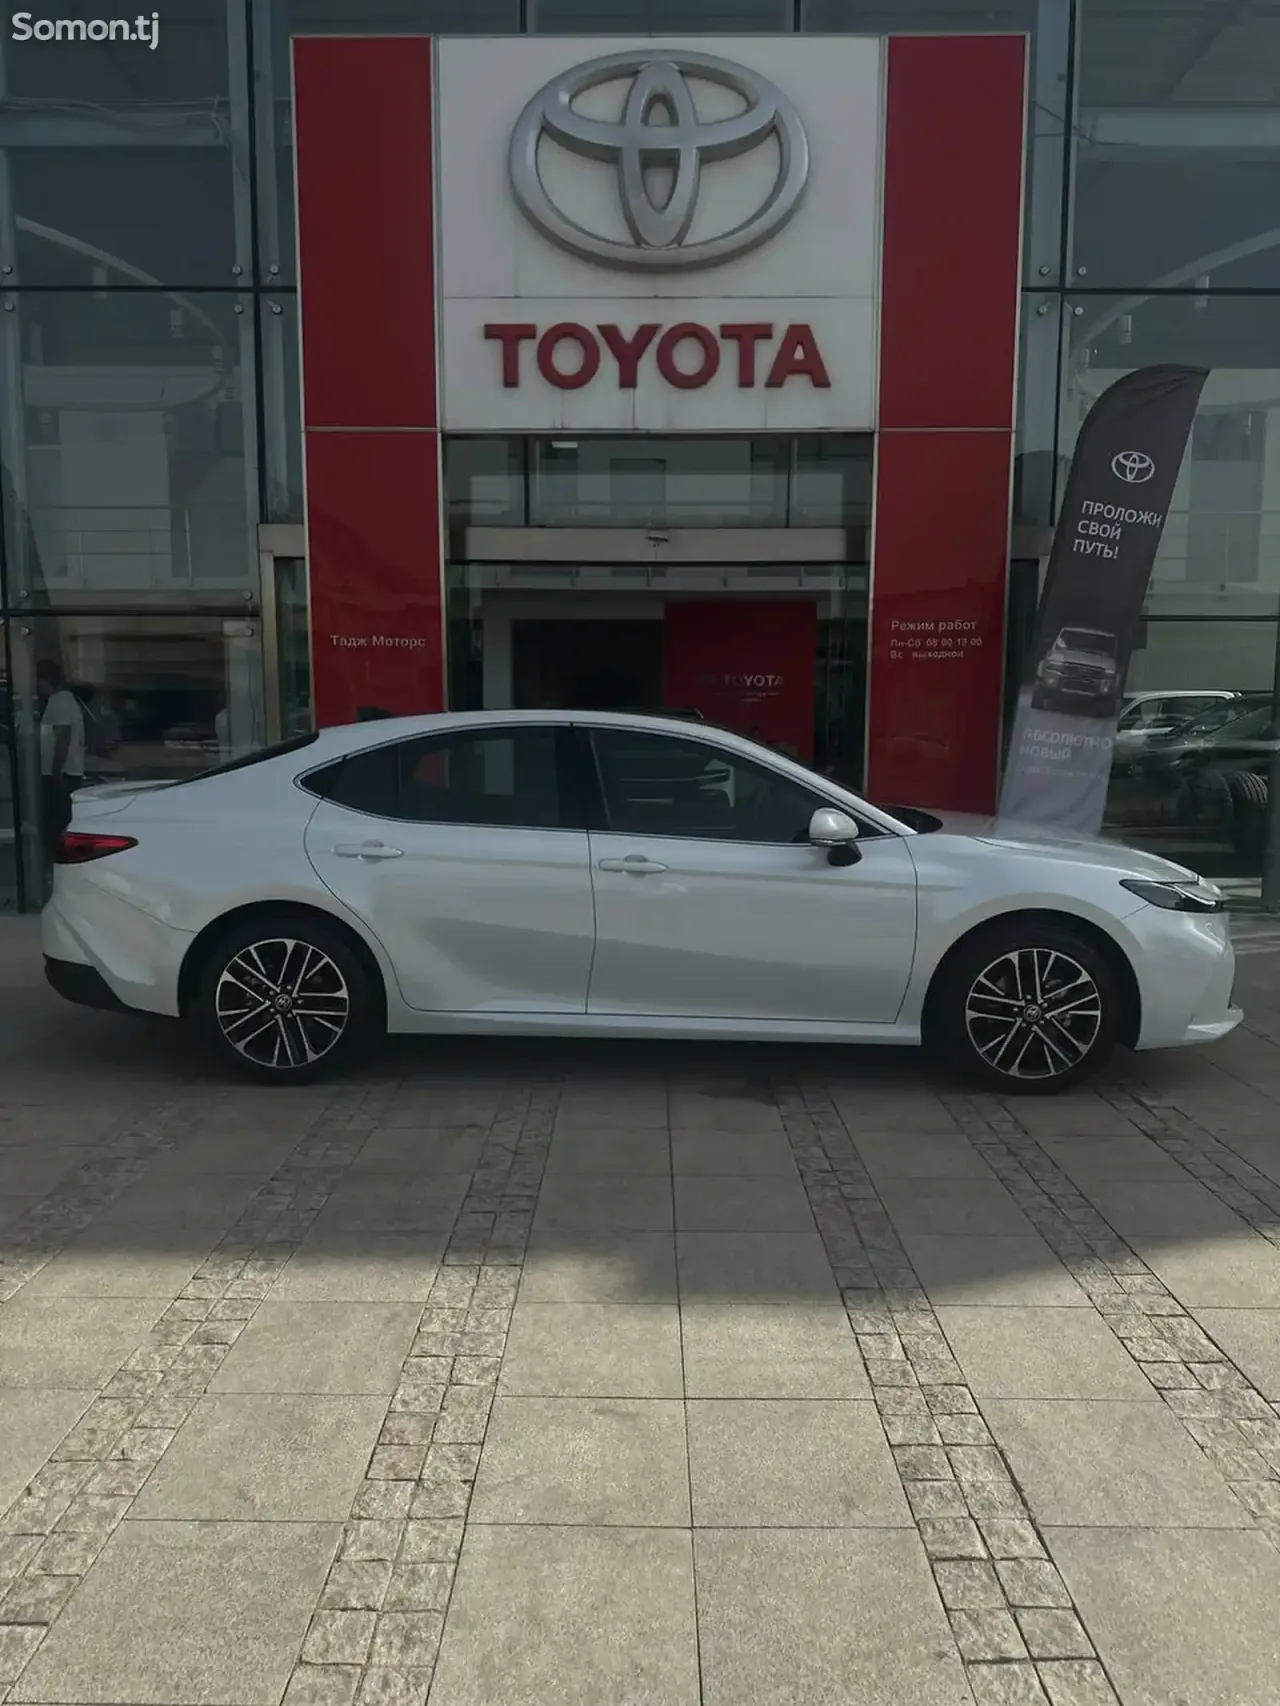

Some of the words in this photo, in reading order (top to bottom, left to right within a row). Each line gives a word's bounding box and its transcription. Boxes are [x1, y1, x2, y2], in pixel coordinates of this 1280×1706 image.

[484, 322, 832, 390] TOYOTA
[1081, 500, 1162, 528] ПРОЛОЖИ
[1077, 520, 1122, 540] СВОЙ
[1072, 538, 1119, 560] ПУТЬ!
[891, 620, 935, 631] Режим
[329, 634, 367, 648] Тадж
[372, 634, 426, 650] Моторс
[724, 674, 783, 687] TOYOTA
